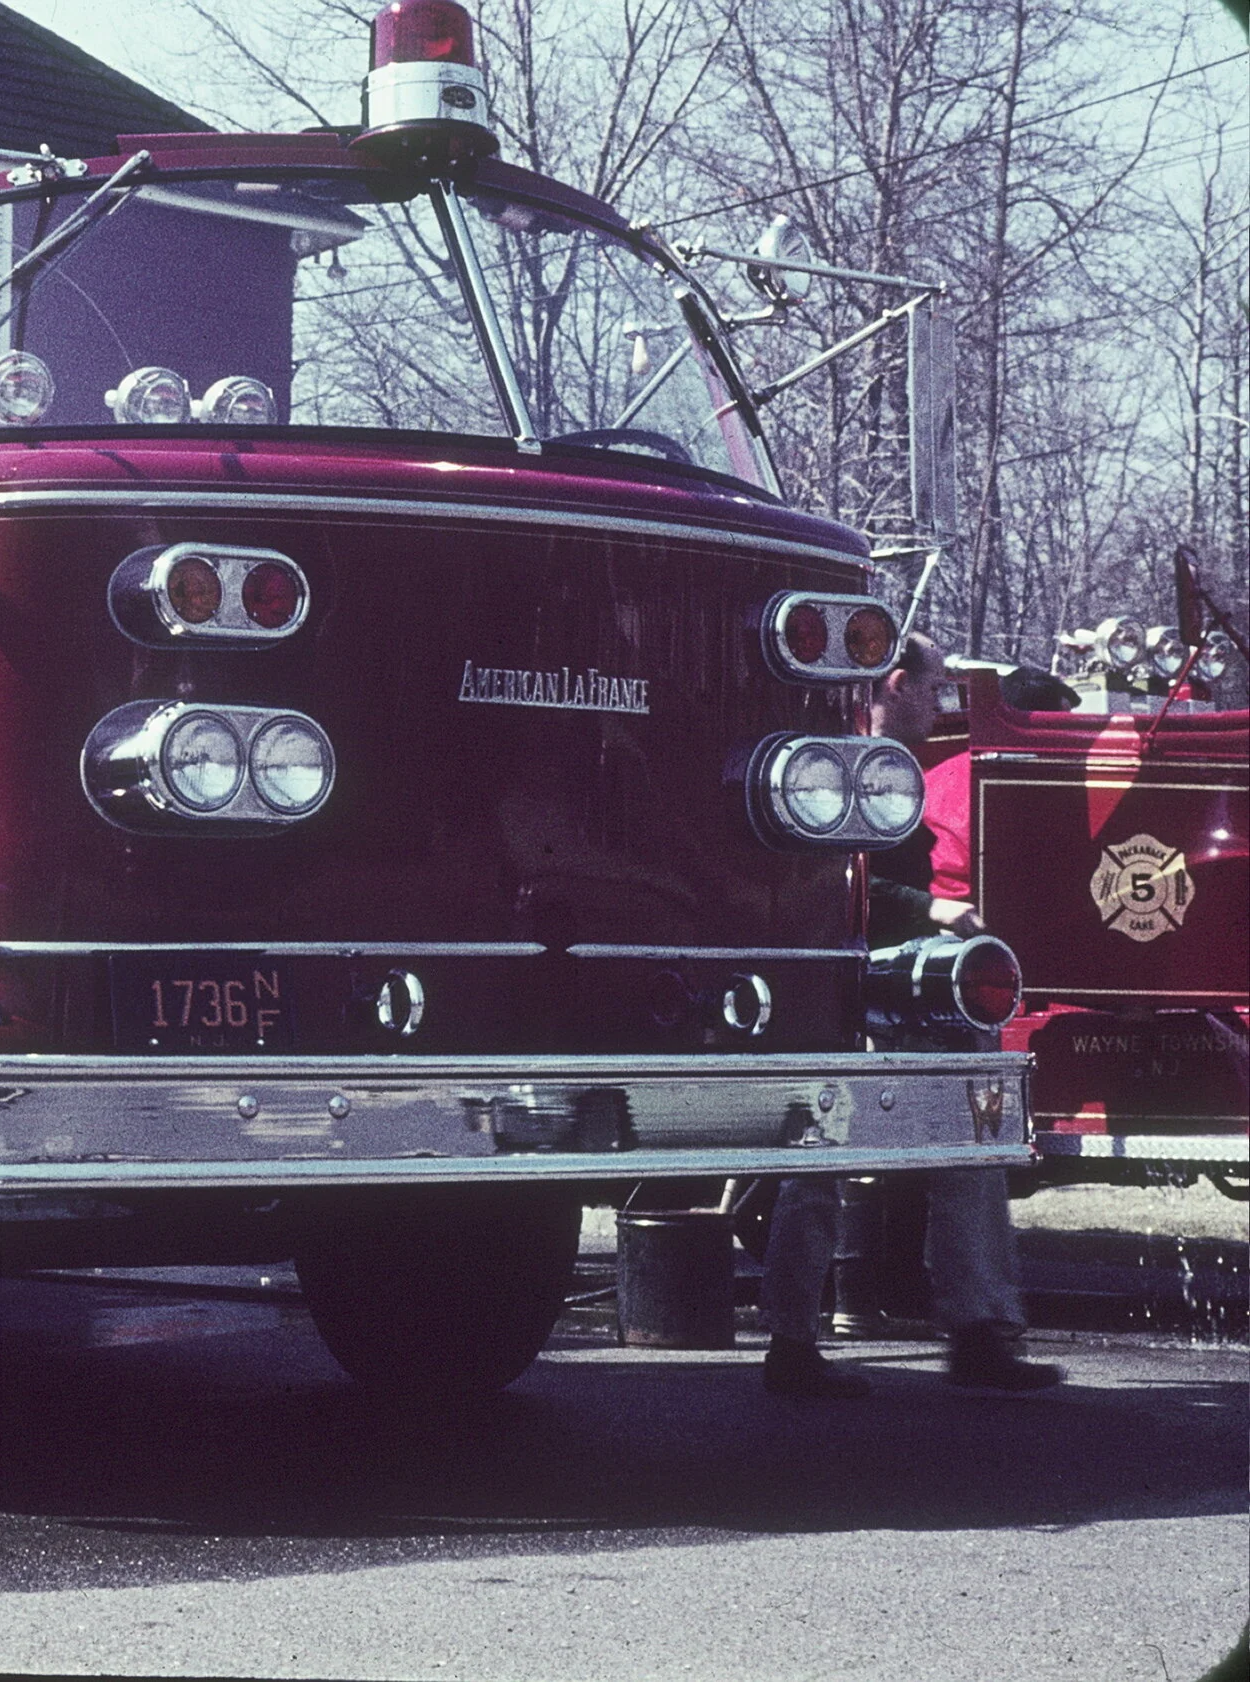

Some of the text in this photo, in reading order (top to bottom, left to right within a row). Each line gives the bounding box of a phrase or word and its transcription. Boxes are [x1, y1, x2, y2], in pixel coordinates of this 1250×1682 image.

[459, 660, 558, 705] AMERICAN
[1131, 873, 1156, 902] 5
[152, 979, 248, 1028] 1736
[1072, 1035, 1141, 1053] WAYNE
